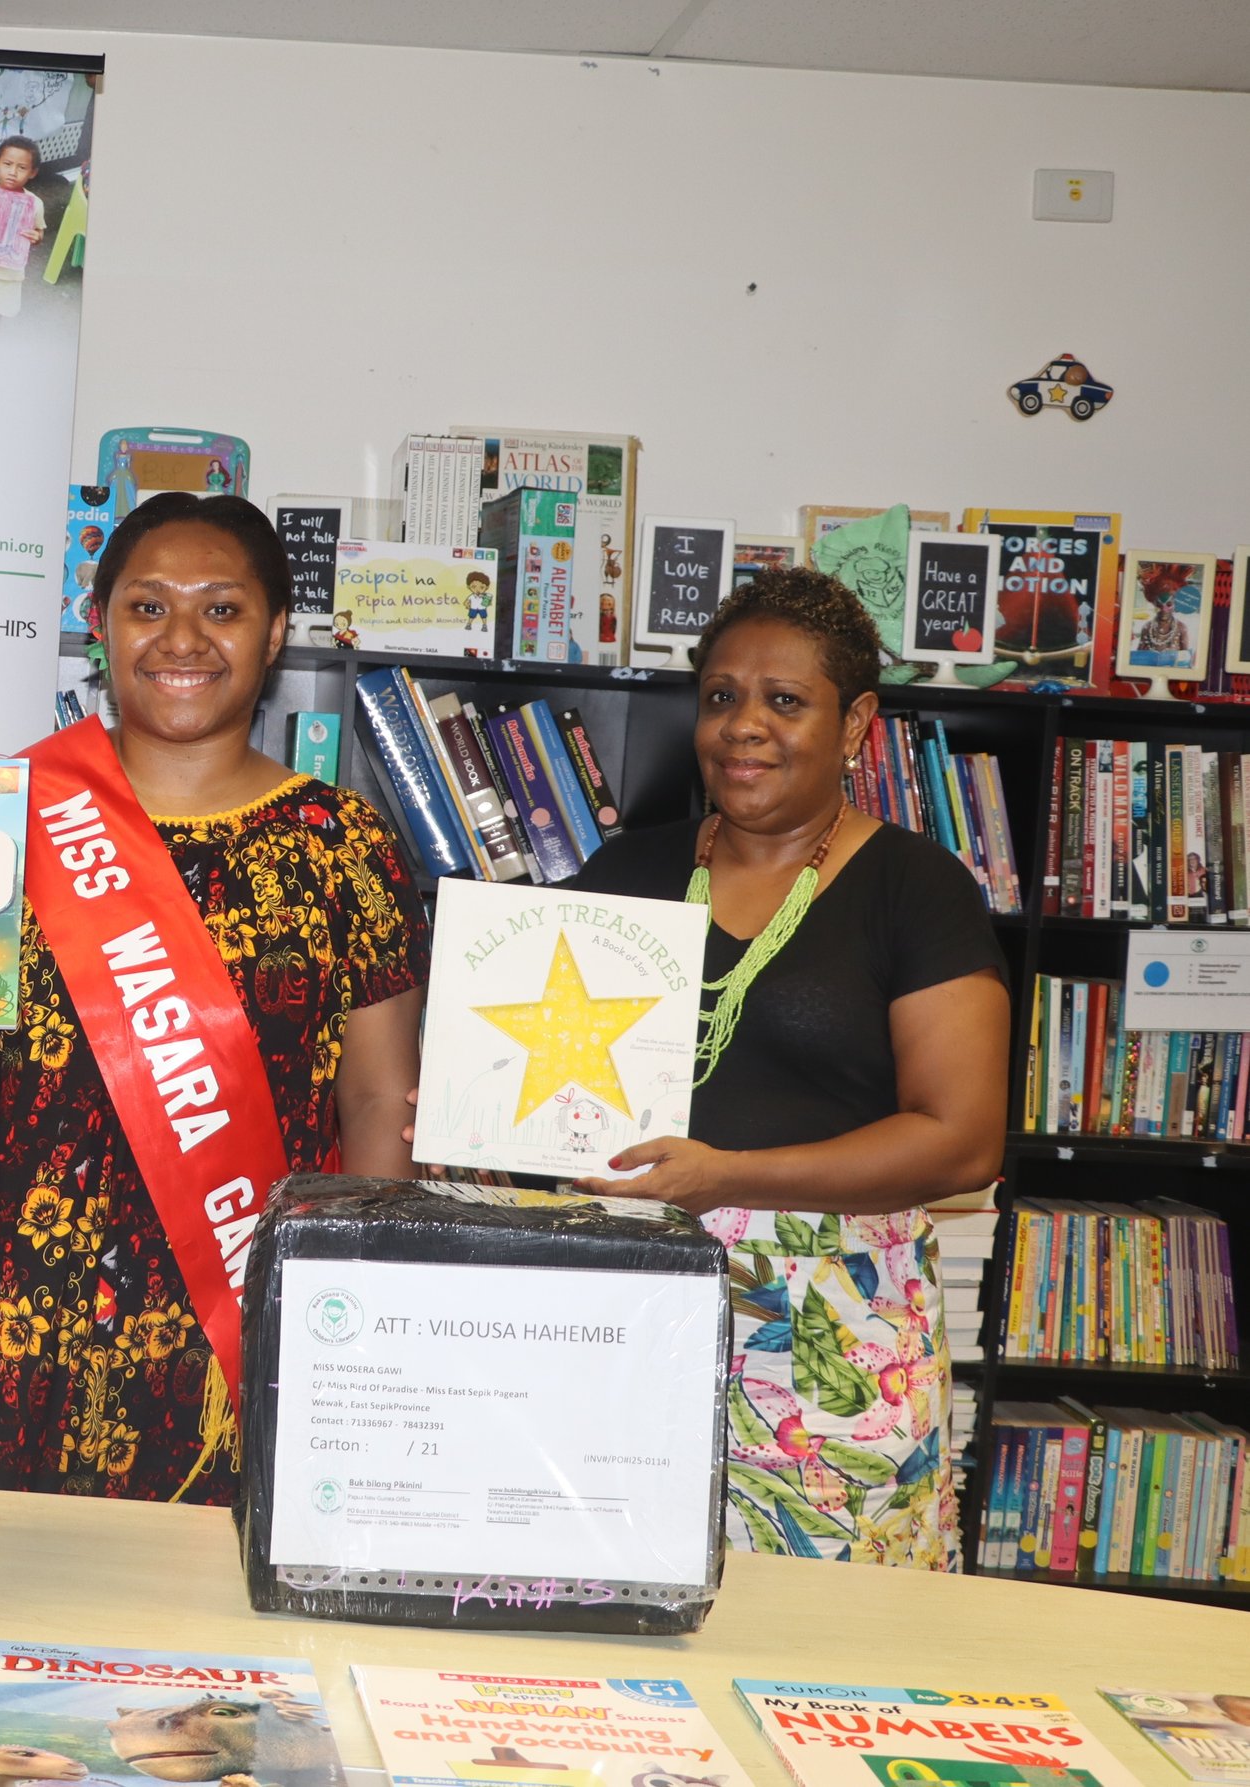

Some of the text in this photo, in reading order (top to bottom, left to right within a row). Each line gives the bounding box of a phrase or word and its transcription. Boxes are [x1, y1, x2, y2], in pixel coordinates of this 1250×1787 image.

[504, 452, 571, 473] ATLAS
[285, 530, 335, 544] not talk
[664, 560, 710, 579] LOVE
[924, 560, 977, 584] Have a
[1010, 557, 1065, 573] AND
[338, 568, 437, 593] Poipoi na
[672, 584, 700, 601] TO
[355, 594, 461, 613] Pipia Monsta
[547, 567, 568, 637] ALPHABET
[922, 590, 978, 614] GREAT
[385, 616, 402, 624] and
[403, 615, 433, 625] Rubbish
[436, 617, 467, 625] Monster
[923, 615, 965, 636] year!
[450, 721, 481, 787] WORLD BOOK
[506, 719, 536, 782] Mathematics
[572, 726, 603, 788] Mathematics
[1069, 748, 1082, 810] ON TRACK
[1113, 754, 1128, 826] WILD MAN
[463, 903, 689, 993] ALL MY TREASURES
[38, 789, 131, 899] MISS
[101, 921, 231, 1154] WASARA
[374, 1317, 626, 1344] ATT VILOUSA HAHEMBE
[313, 1363, 402, 1375] MISS WOSERA GAWI
[0, 1653, 288, 1686] DINOSAUR
[461, 1674, 598, 1689] SCHOLASTIC
[762, 1697, 902, 1715] My Book of
[774, 1685, 868, 1698] KUMON
[915, 1692, 945, 1703] Ages
[380, 1698, 687, 1723] Road to NAPLAN Success
[420, 1712, 672, 1743] Handwriting
[771, 1710, 1085, 1747] NUMBERS
[393, 1728, 715, 1762] and Vocabulary
